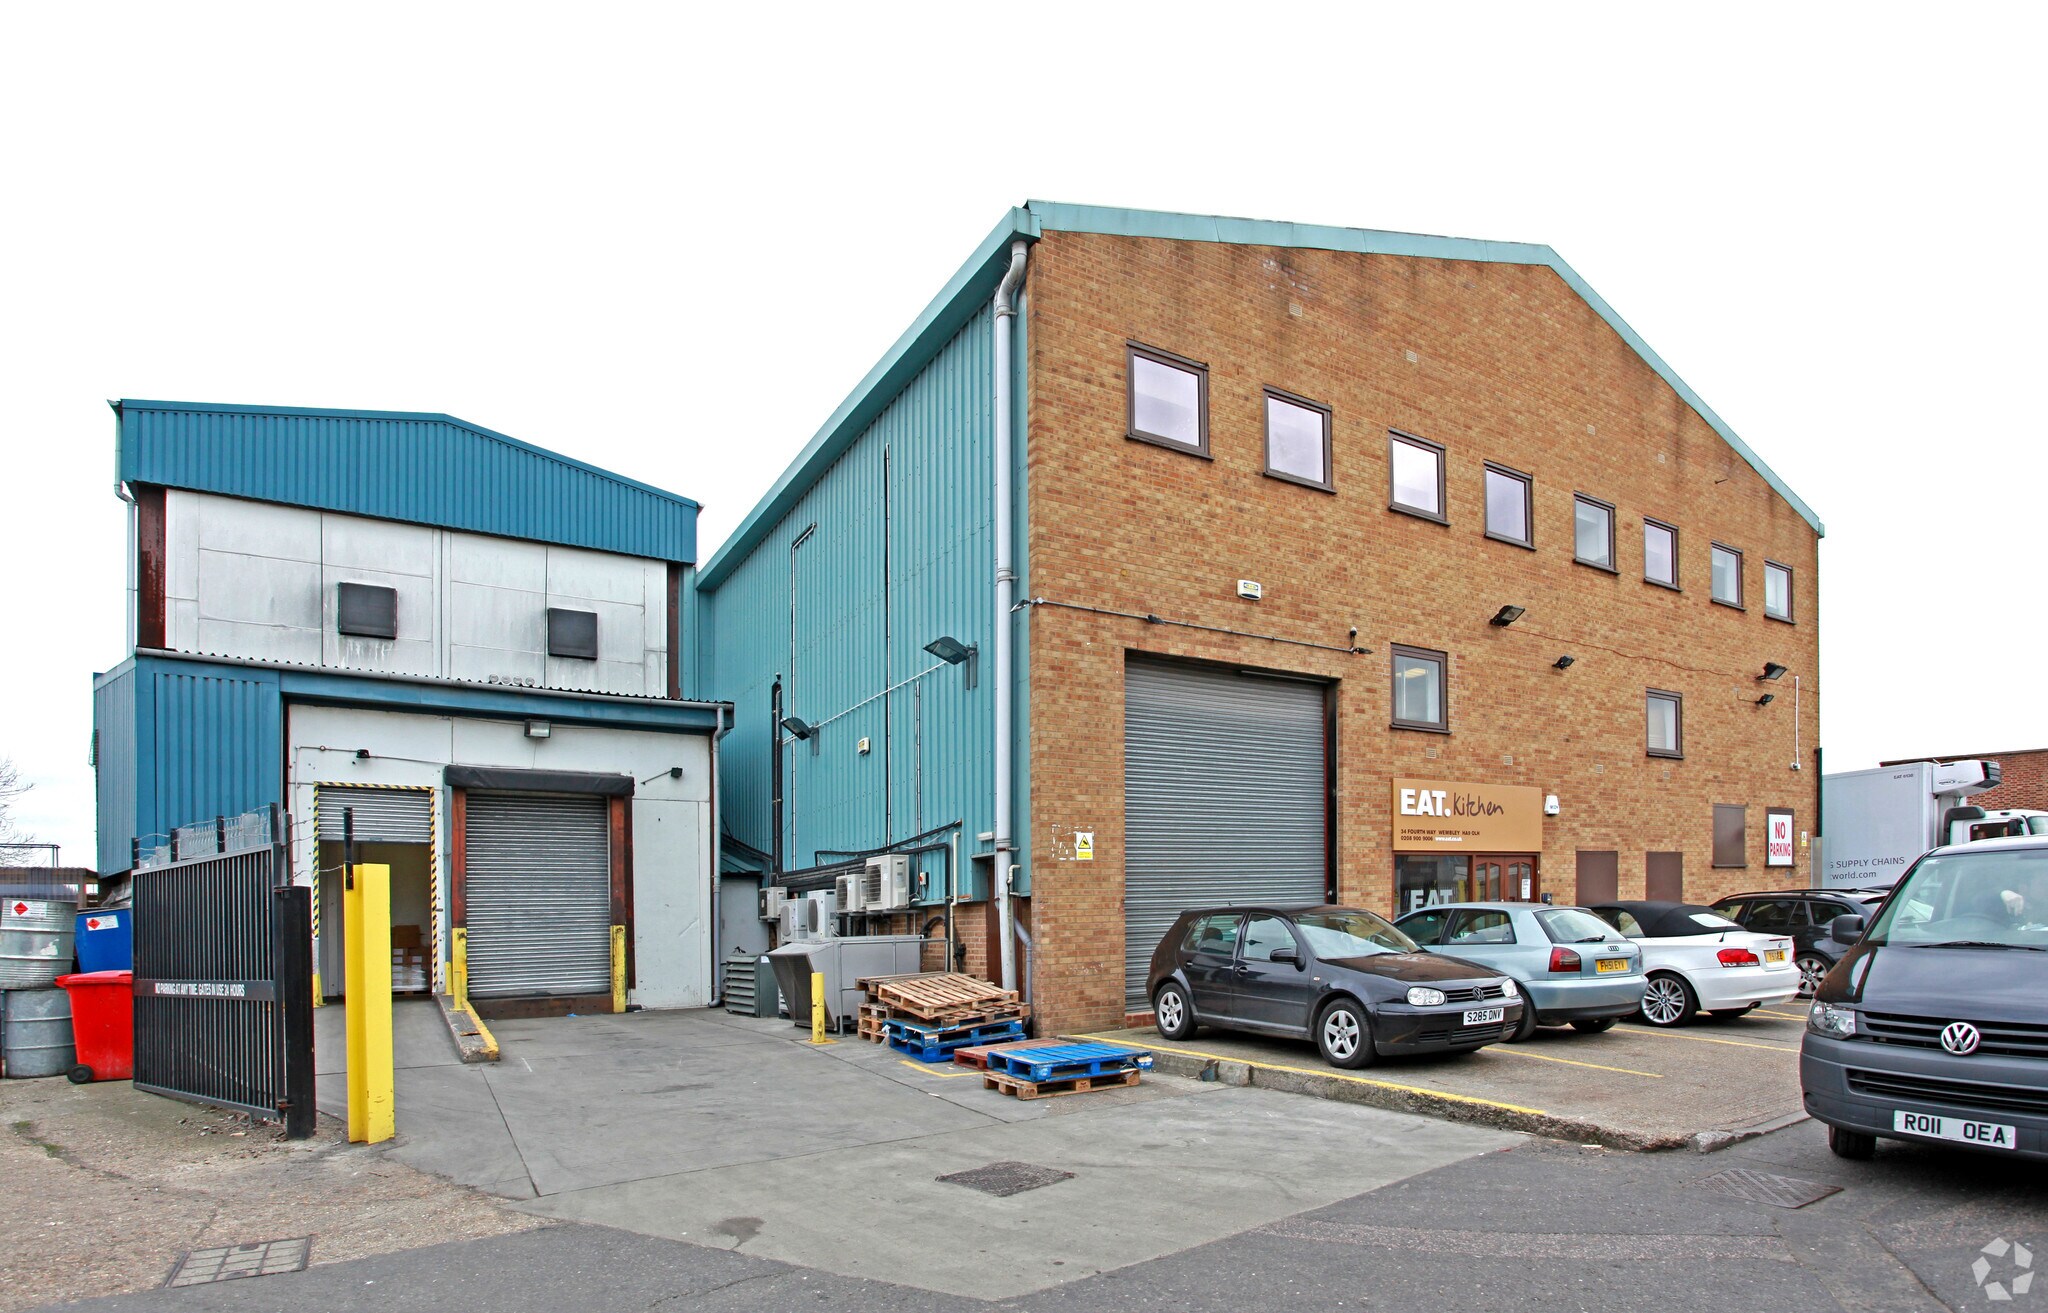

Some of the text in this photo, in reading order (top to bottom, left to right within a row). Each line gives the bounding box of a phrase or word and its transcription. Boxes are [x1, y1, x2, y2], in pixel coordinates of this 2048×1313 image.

[1400, 788, 1451, 817] EAT.
[1774, 821, 1786, 839] NO
[1769, 842, 1791, 857] PARKING
[1836, 858, 1869, 869] SUPPLY
[1871, 856, 1905, 866] CHAINS
[1831, 871, 1877, 880] world.com
[230, 984, 245, 997] HOURS
[1466, 1010, 1488, 1023] S285
[1904, 1113, 2006, 1144] RO11 OEA
